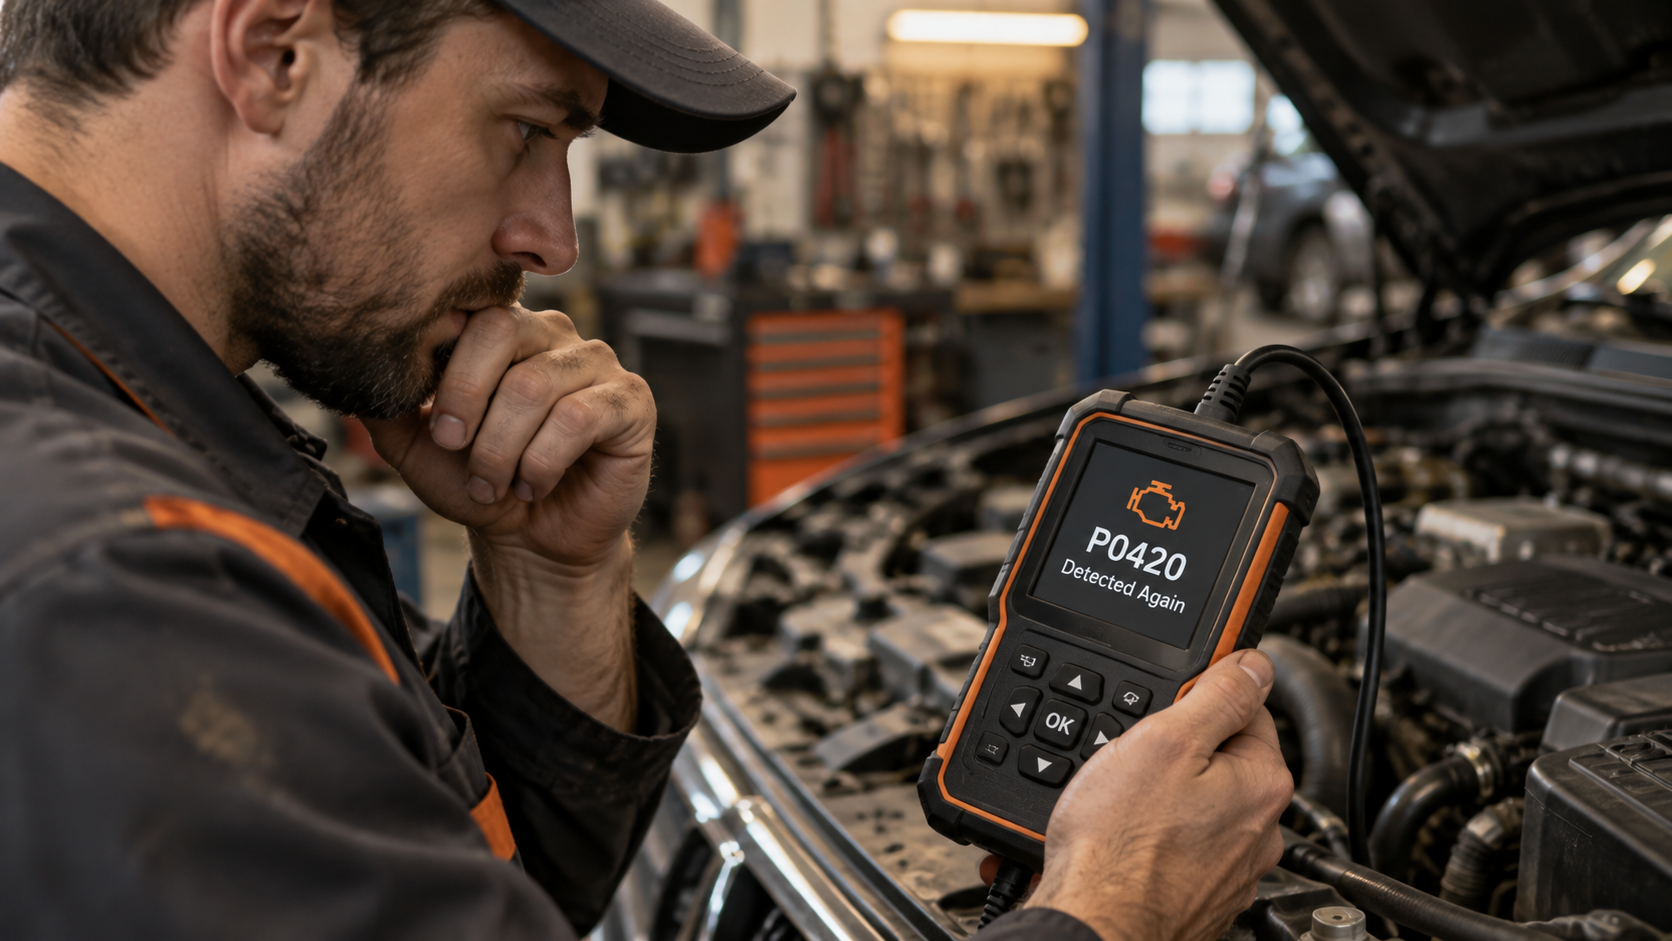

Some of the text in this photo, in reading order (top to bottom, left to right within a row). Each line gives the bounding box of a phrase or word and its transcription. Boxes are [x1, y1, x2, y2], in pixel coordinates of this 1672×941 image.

[1085, 525, 1187, 582] P0420
[1060, 558, 1186, 614] Detected Again
[1045, 712, 1075, 736] OK
